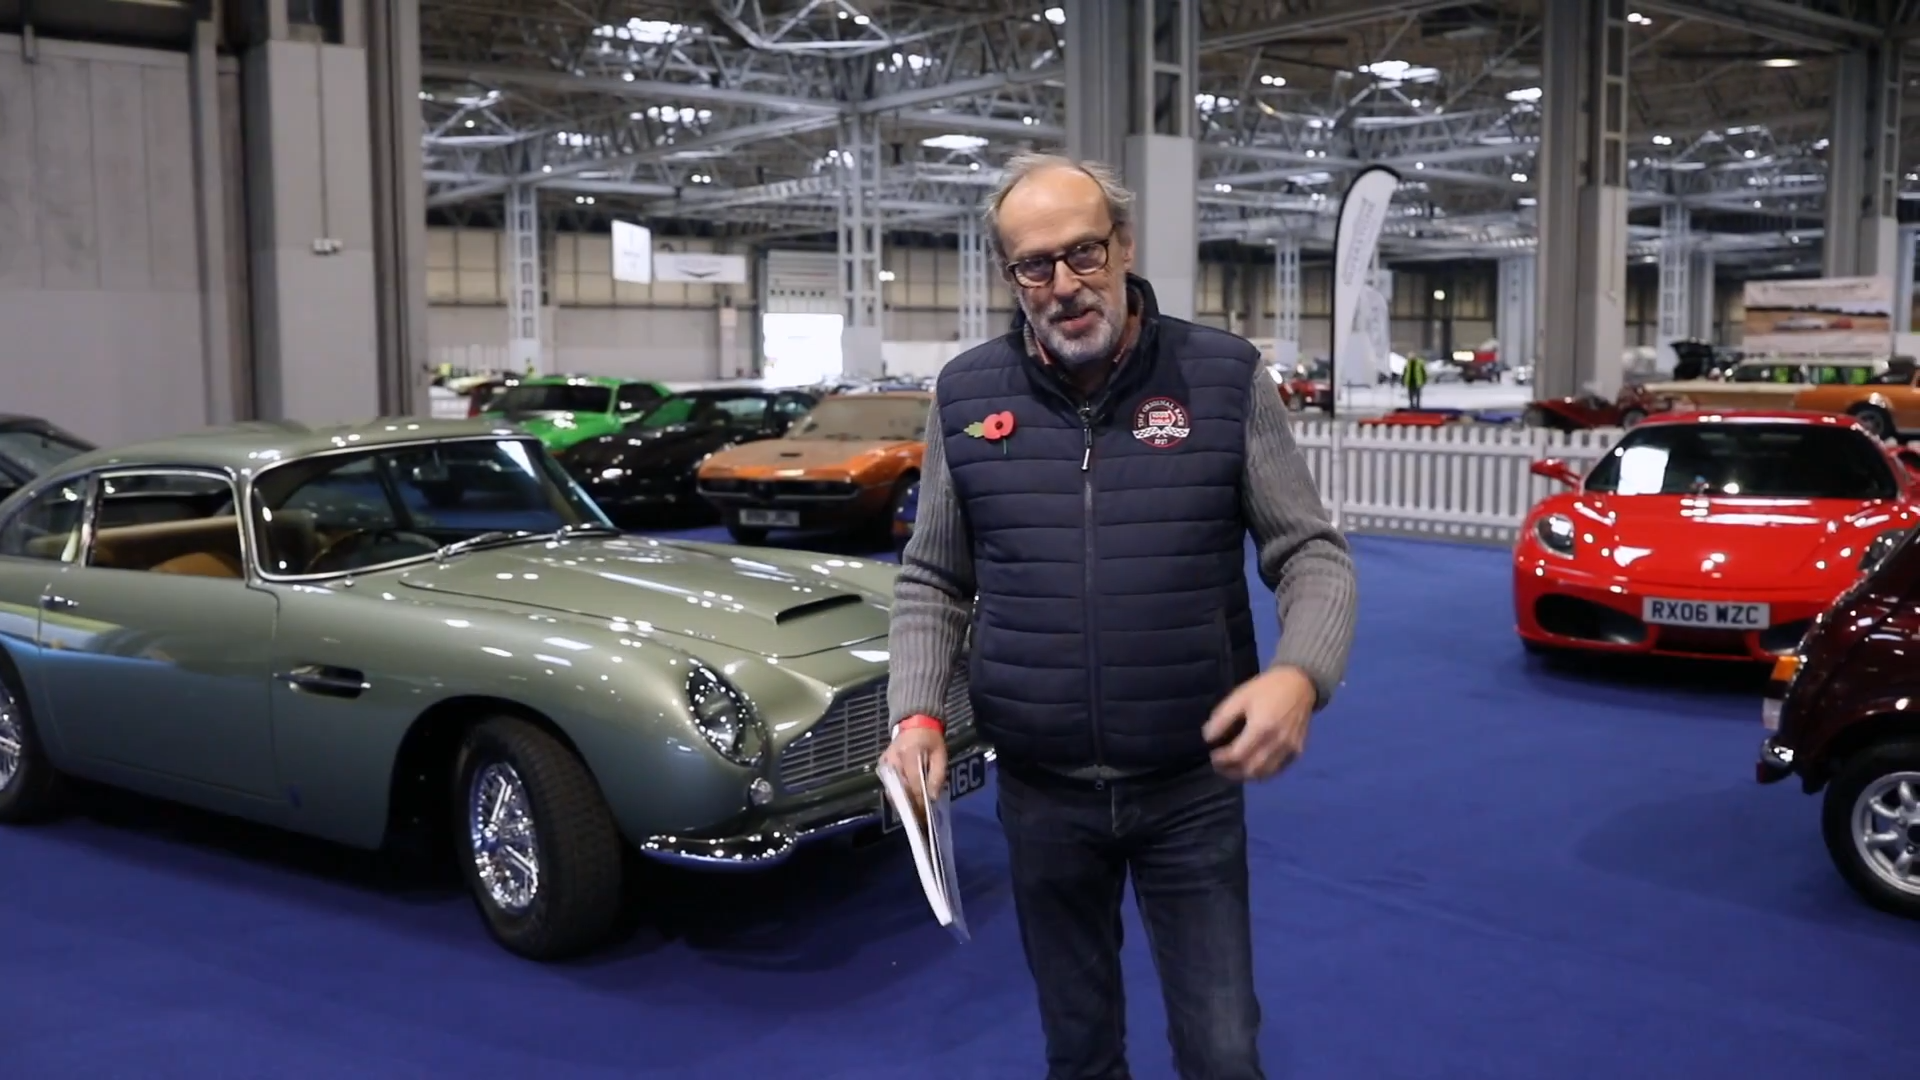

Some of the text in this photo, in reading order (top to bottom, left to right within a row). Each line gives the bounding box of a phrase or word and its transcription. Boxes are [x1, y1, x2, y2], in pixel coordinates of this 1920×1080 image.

[1651, 600, 1759, 625] RX06 WZC
[943, 757, 982, 797] 16C
